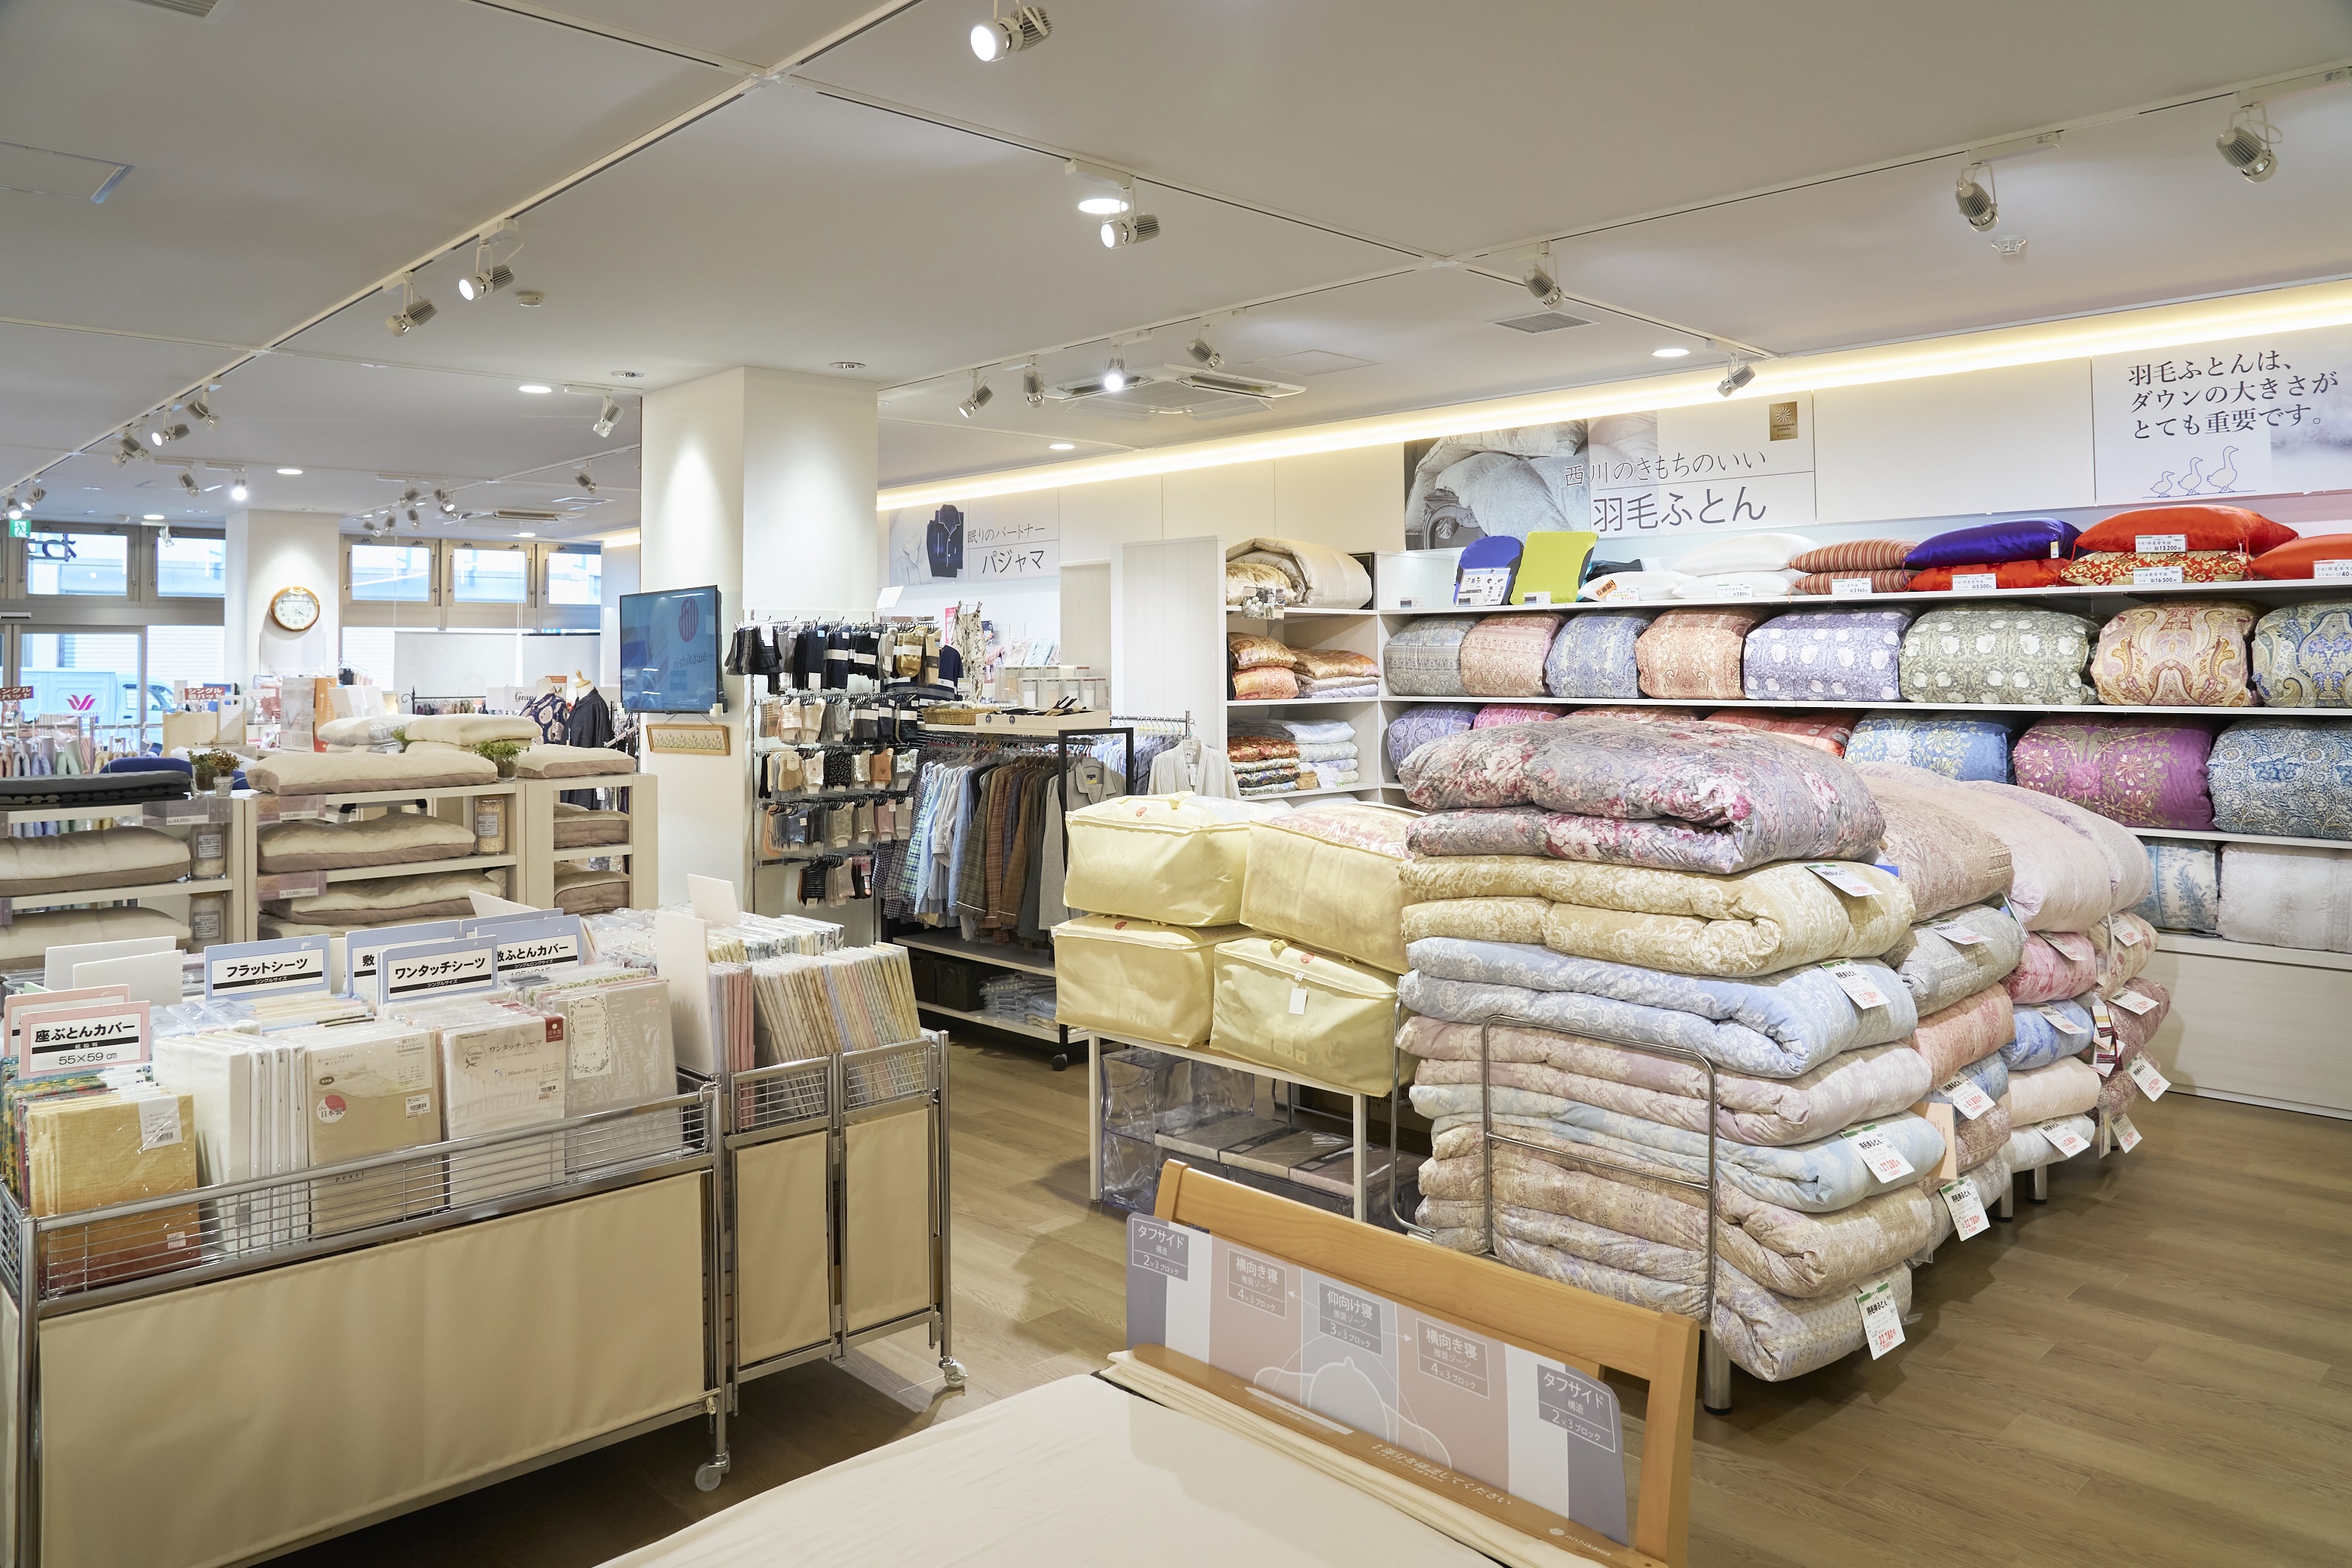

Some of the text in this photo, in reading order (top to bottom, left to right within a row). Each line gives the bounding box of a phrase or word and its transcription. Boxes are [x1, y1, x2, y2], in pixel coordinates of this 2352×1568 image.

[2127, 350, 2292, 387] 羽毛ふとんは、
[2130, 371, 2338, 413] ダウンの大きさが
[2134, 403, 2321, 439] とても重要です。
[1564, 451, 1766, 487] 西川のきもちのいい
[1593, 486, 1766, 532] 羽毛ふとん
[967, 523, 1045, 544] 眠りのパートナー
[982, 549, 1044, 574] パジャマ
[673, 651, 707, 670] nishikawa
[226, 958, 308, 978] フラットシーツ
[395, 957, 485, 979] ワンタッチシーツ
[514, 959, 553, 969] シングルロングサイズ
[255, 975, 287, 985] シングルサイズ
[427, 978, 458, 988] シングルサイズ
[35, 1021, 135, 1043] 座ぶとんカバー
[489, 1039, 542, 1053] ワンタッチシーツ
[320, 1107, 343, 1118] 日本製
[335, 1171, 365, 1183] pearl
[1138, 1224, 1185, 1249] タフサイド
[1156, 1245, 1168, 1255] 構造
[1236, 1256, 1279, 1285] 横向き寝
[1327, 1289, 1373, 1319] 仰向け寝
[1334, 1309, 1367, 1328] 推奨ゾーン
[1426, 1328, 1478, 1360] 横向き寝
[1434, 1348, 1472, 1368] 推奨ゾーン
[1543, 1372, 1604, 1409] タフサイド
[1567, 1399, 1584, 1415] 構造
[1565, 1535, 1612, 1557] nishikawa
